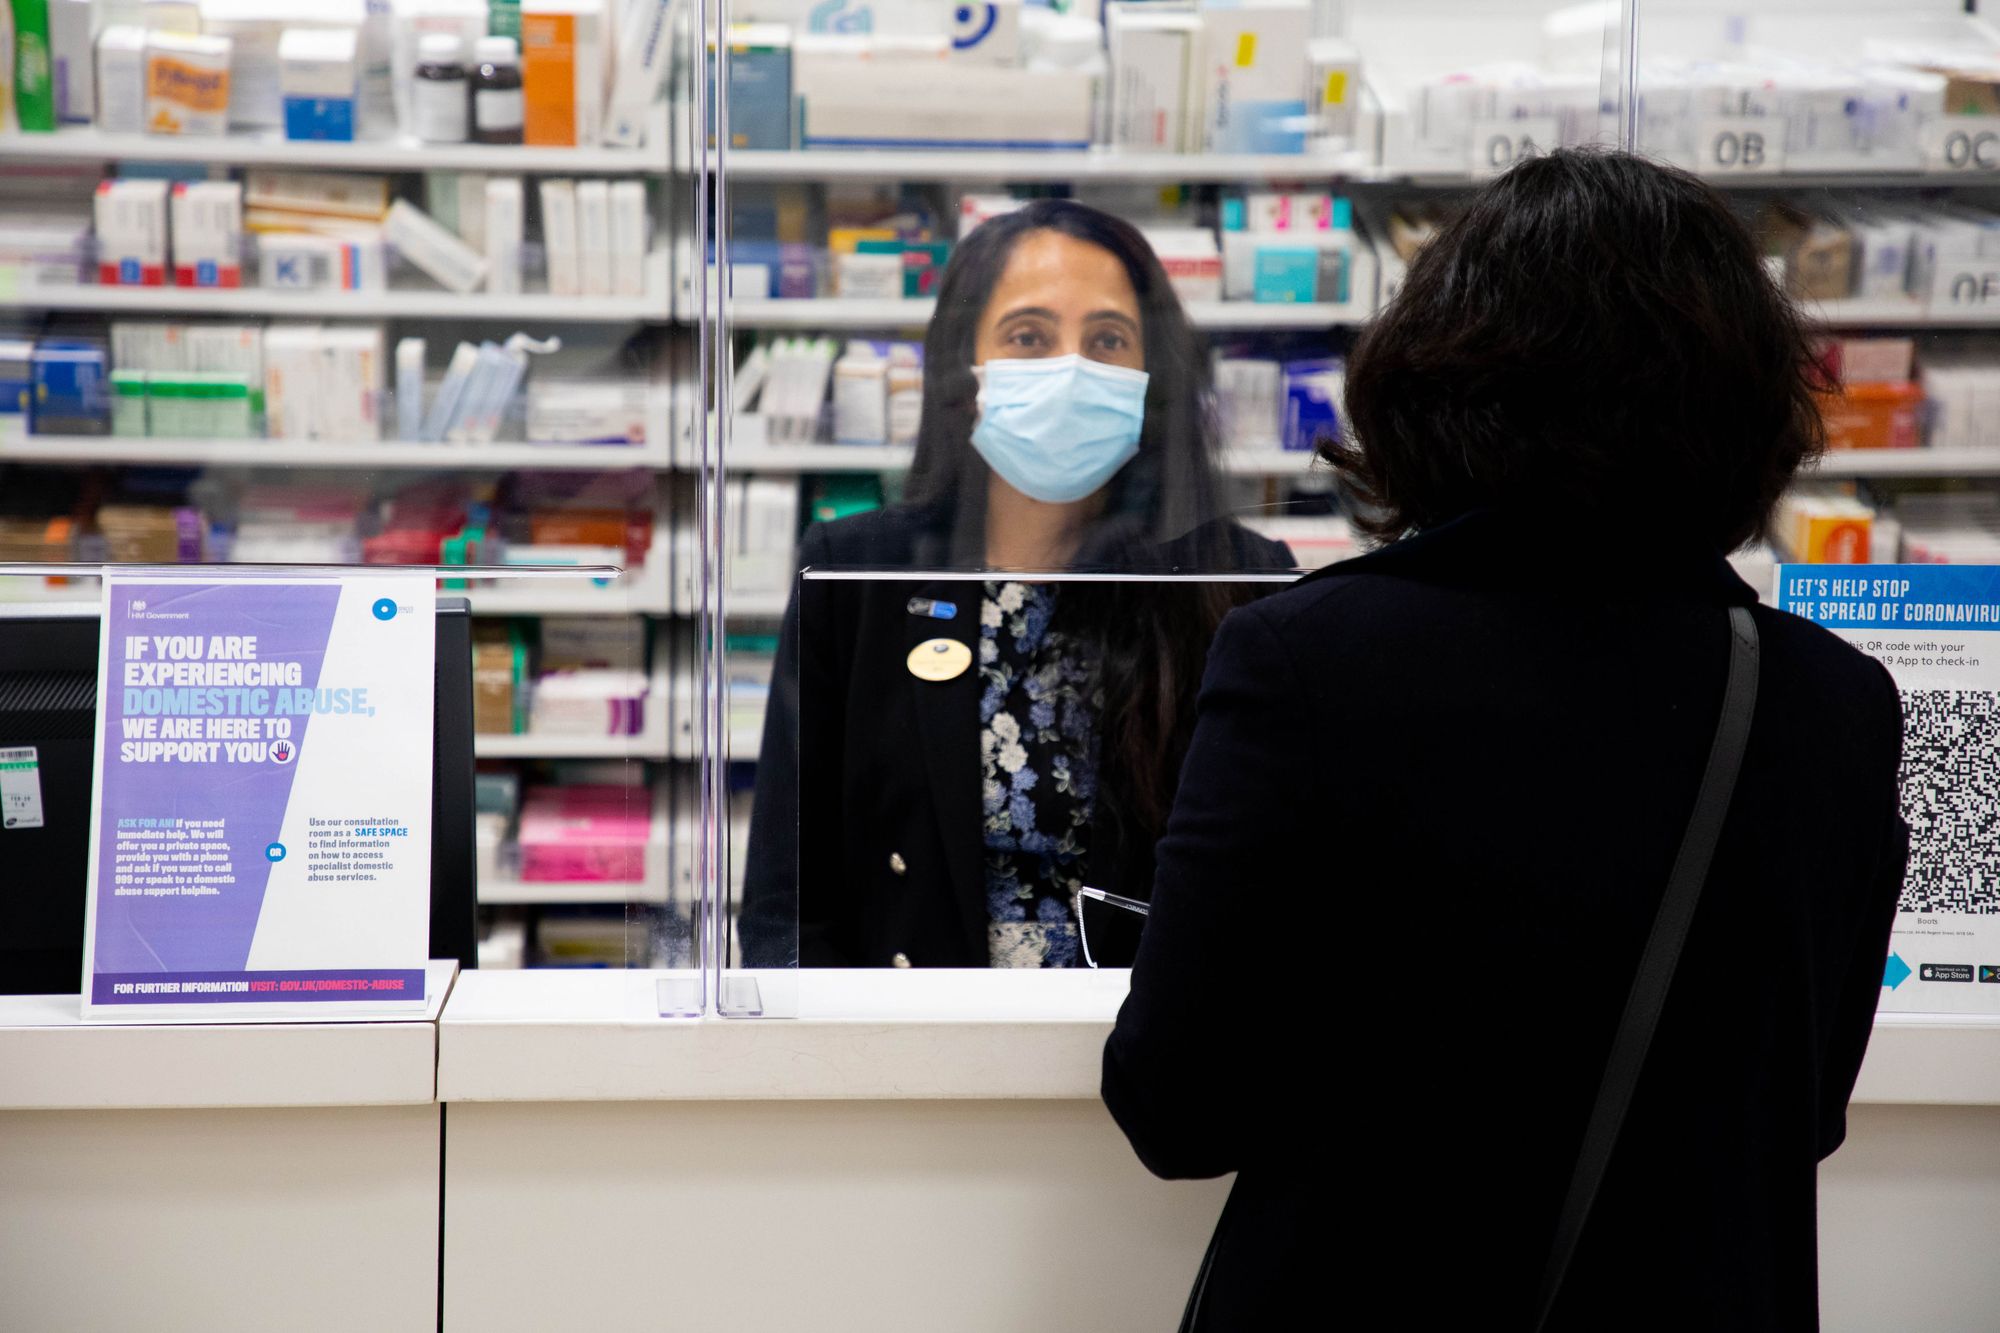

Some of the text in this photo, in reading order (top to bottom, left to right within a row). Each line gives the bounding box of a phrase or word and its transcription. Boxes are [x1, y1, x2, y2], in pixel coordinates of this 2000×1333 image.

[1790, 579, 1909, 597] LET'S HELP STOP
[1788, 602, 1815, 620] THE
[1819, 603, 1876, 620] SPREAD
[1882, 603, 1899, 621] OF
[125, 636, 257, 659] IF YOU ARE
[1849, 641, 1965, 653] his QR code with your
[1897, 656, 1918, 666] App
[1922, 657, 1932, 665] to
[1936, 657, 1979, 666] check-in
[124, 662, 302, 686] EXPERIENCING
[123, 687, 375, 717] DOMESTIC ABUSE,
[122, 718, 291, 739] WE ARE HERE TO
[120, 742, 266, 762] SUPPORT YOU
[118, 819, 137, 828] ASK
[139, 819, 157, 827] FOR
[185, 820, 201, 829] you
[203, 819, 224, 827] need
[309, 818, 325, 826] Use
[344, 817, 399, 826] consultation
[117, 830, 224, 840] immediate help. We will
[355, 828, 377, 836] SAFE
[380, 828, 408, 836] SPACE
[117, 842, 139, 850] offer
[141, 843, 158, 852] you
[166, 842, 199, 851] private
[201, 842, 230, 851] space,
[309, 840, 389, 848] to find information
[270, 848, 281, 856] OR
[321, 851, 339, 859] how
[342, 851, 351, 859] to
[116, 853, 151, 863] provide
[153, 854, 170, 862] you
[171, 852, 192, 861] with
[201, 852, 228, 862] phone
[116, 864, 133, 873] and
[134, 864, 151, 873] ask
[153, 863, 160, 872] if
[161, 865, 178, 874] you
[204, 864, 213, 872] to
[215, 863, 232, 872] call
[308, 862, 393, 871] specialist domestic
[146, 876, 173, 885] speak
[175, 876, 185, 884] to
[194, 875, 235, 883] domestic
[308, 873, 377, 881] abuse services.
[115, 886, 220, 896] abuse support helpline.
[114, 980, 404, 994] FOR FURTHER INFORMATION VISIT: GOV.UK/DOMESTIC-ABUSE
